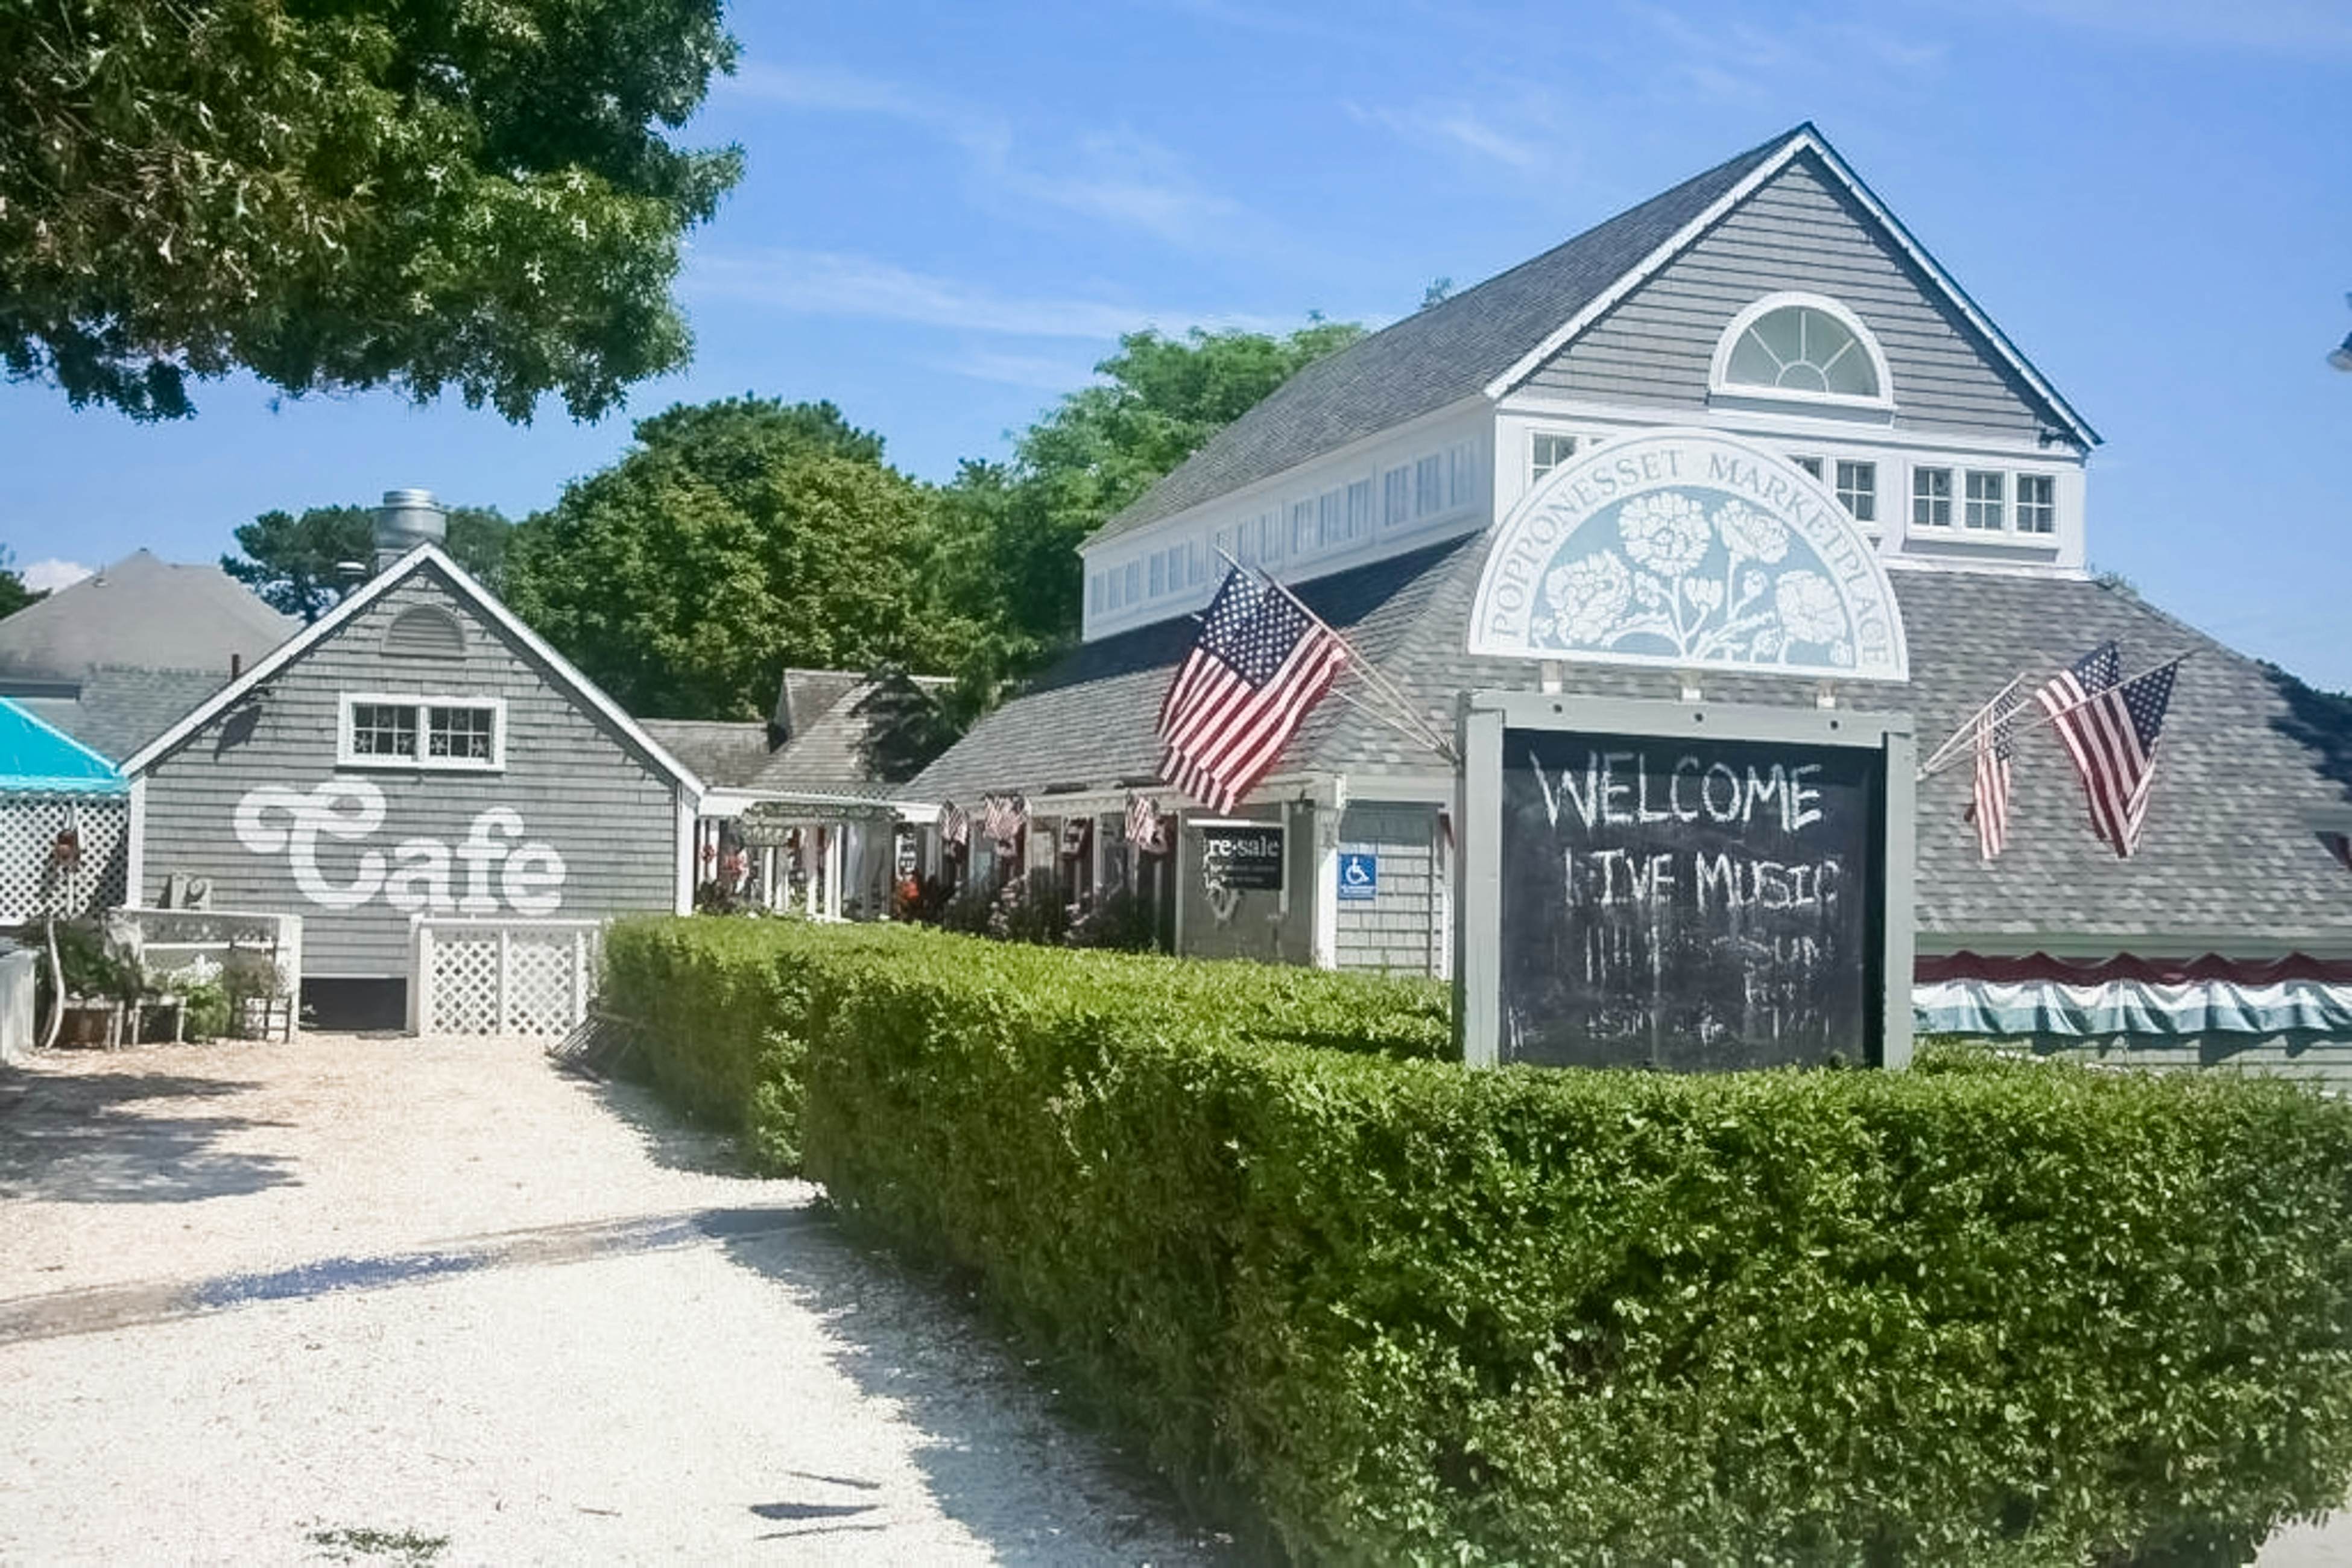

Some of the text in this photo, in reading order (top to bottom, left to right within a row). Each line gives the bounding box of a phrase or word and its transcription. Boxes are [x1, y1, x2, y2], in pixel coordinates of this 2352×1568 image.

[1491, 449, 1889, 665] POPPONESSET MARKETPLACE
[1529, 749, 1822, 833] WELCOME
[233, 779, 566, 916] Cafe
[1695, 850, 1841, 915] MUSIC
